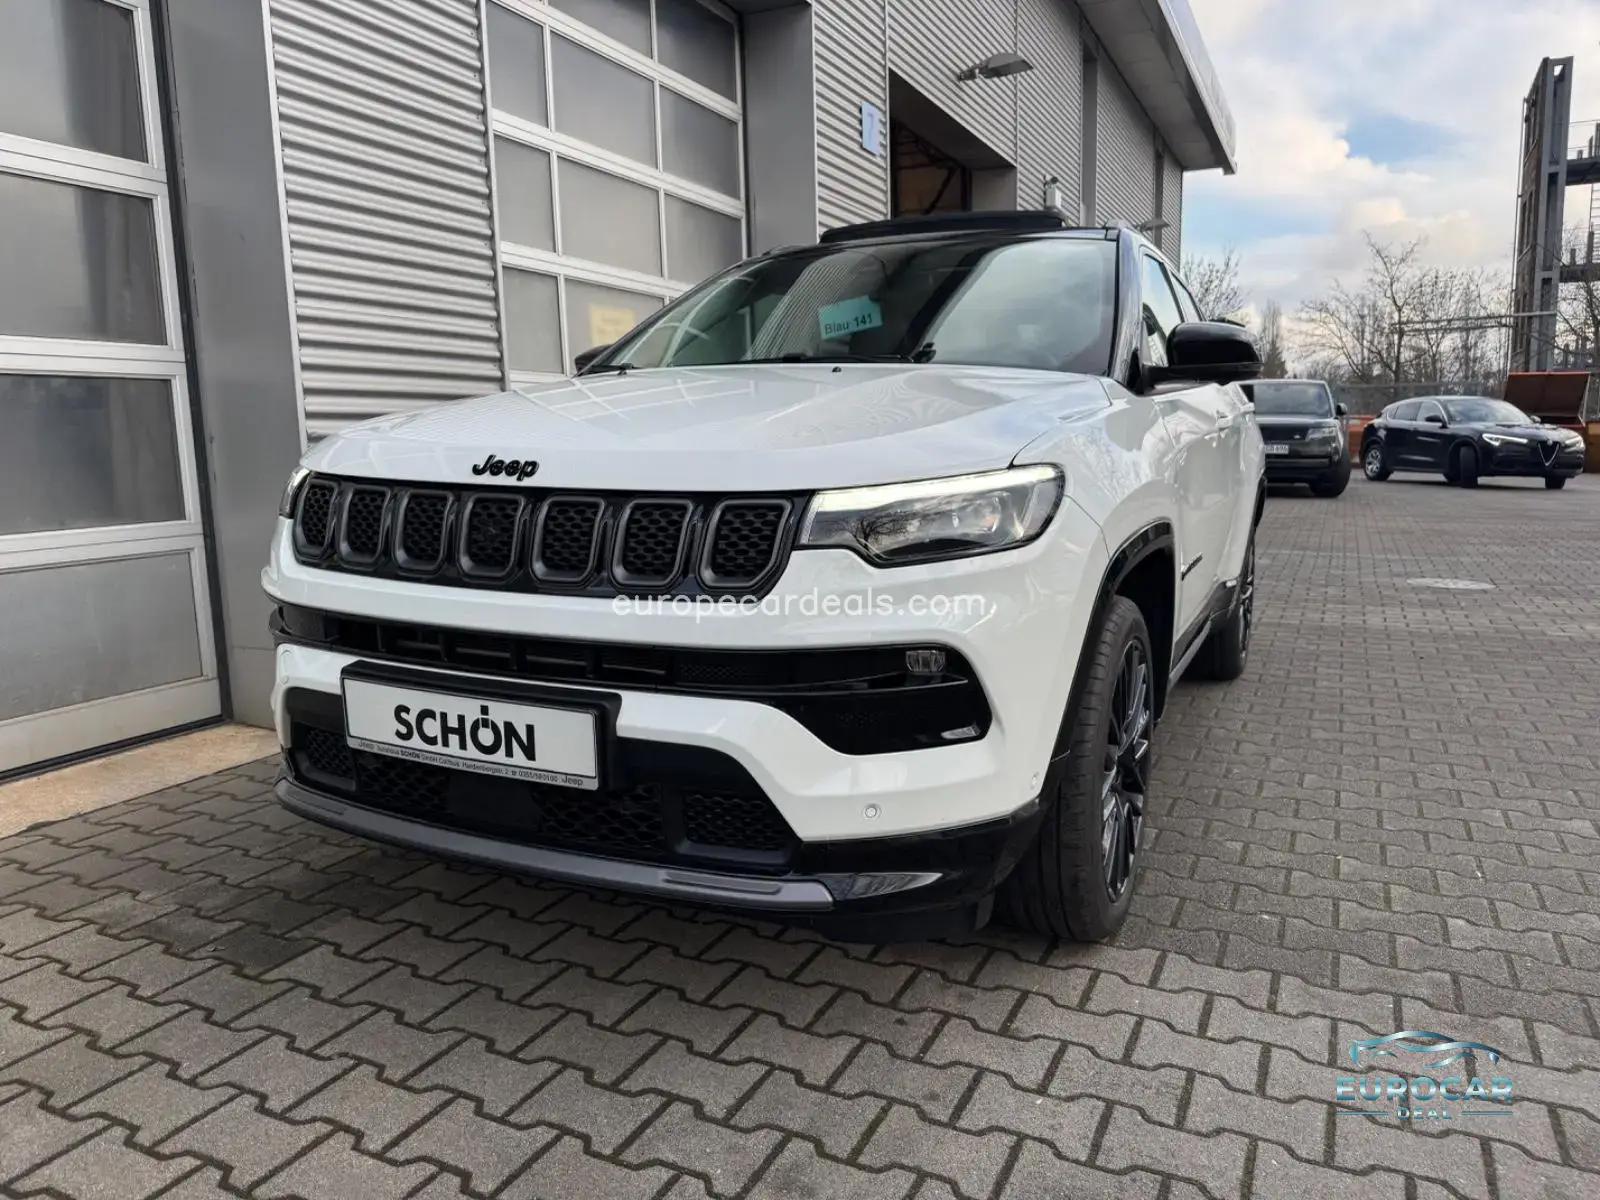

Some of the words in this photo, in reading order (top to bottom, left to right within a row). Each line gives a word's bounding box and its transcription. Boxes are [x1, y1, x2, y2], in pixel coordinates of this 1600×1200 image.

[825, 321, 849, 335] Blau
[854, 313, 873, 328] 141
[472, 454, 540, 482] Jeep
[393, 704, 537, 762] SCHÖN
[561, 775, 584, 789] Jeep
